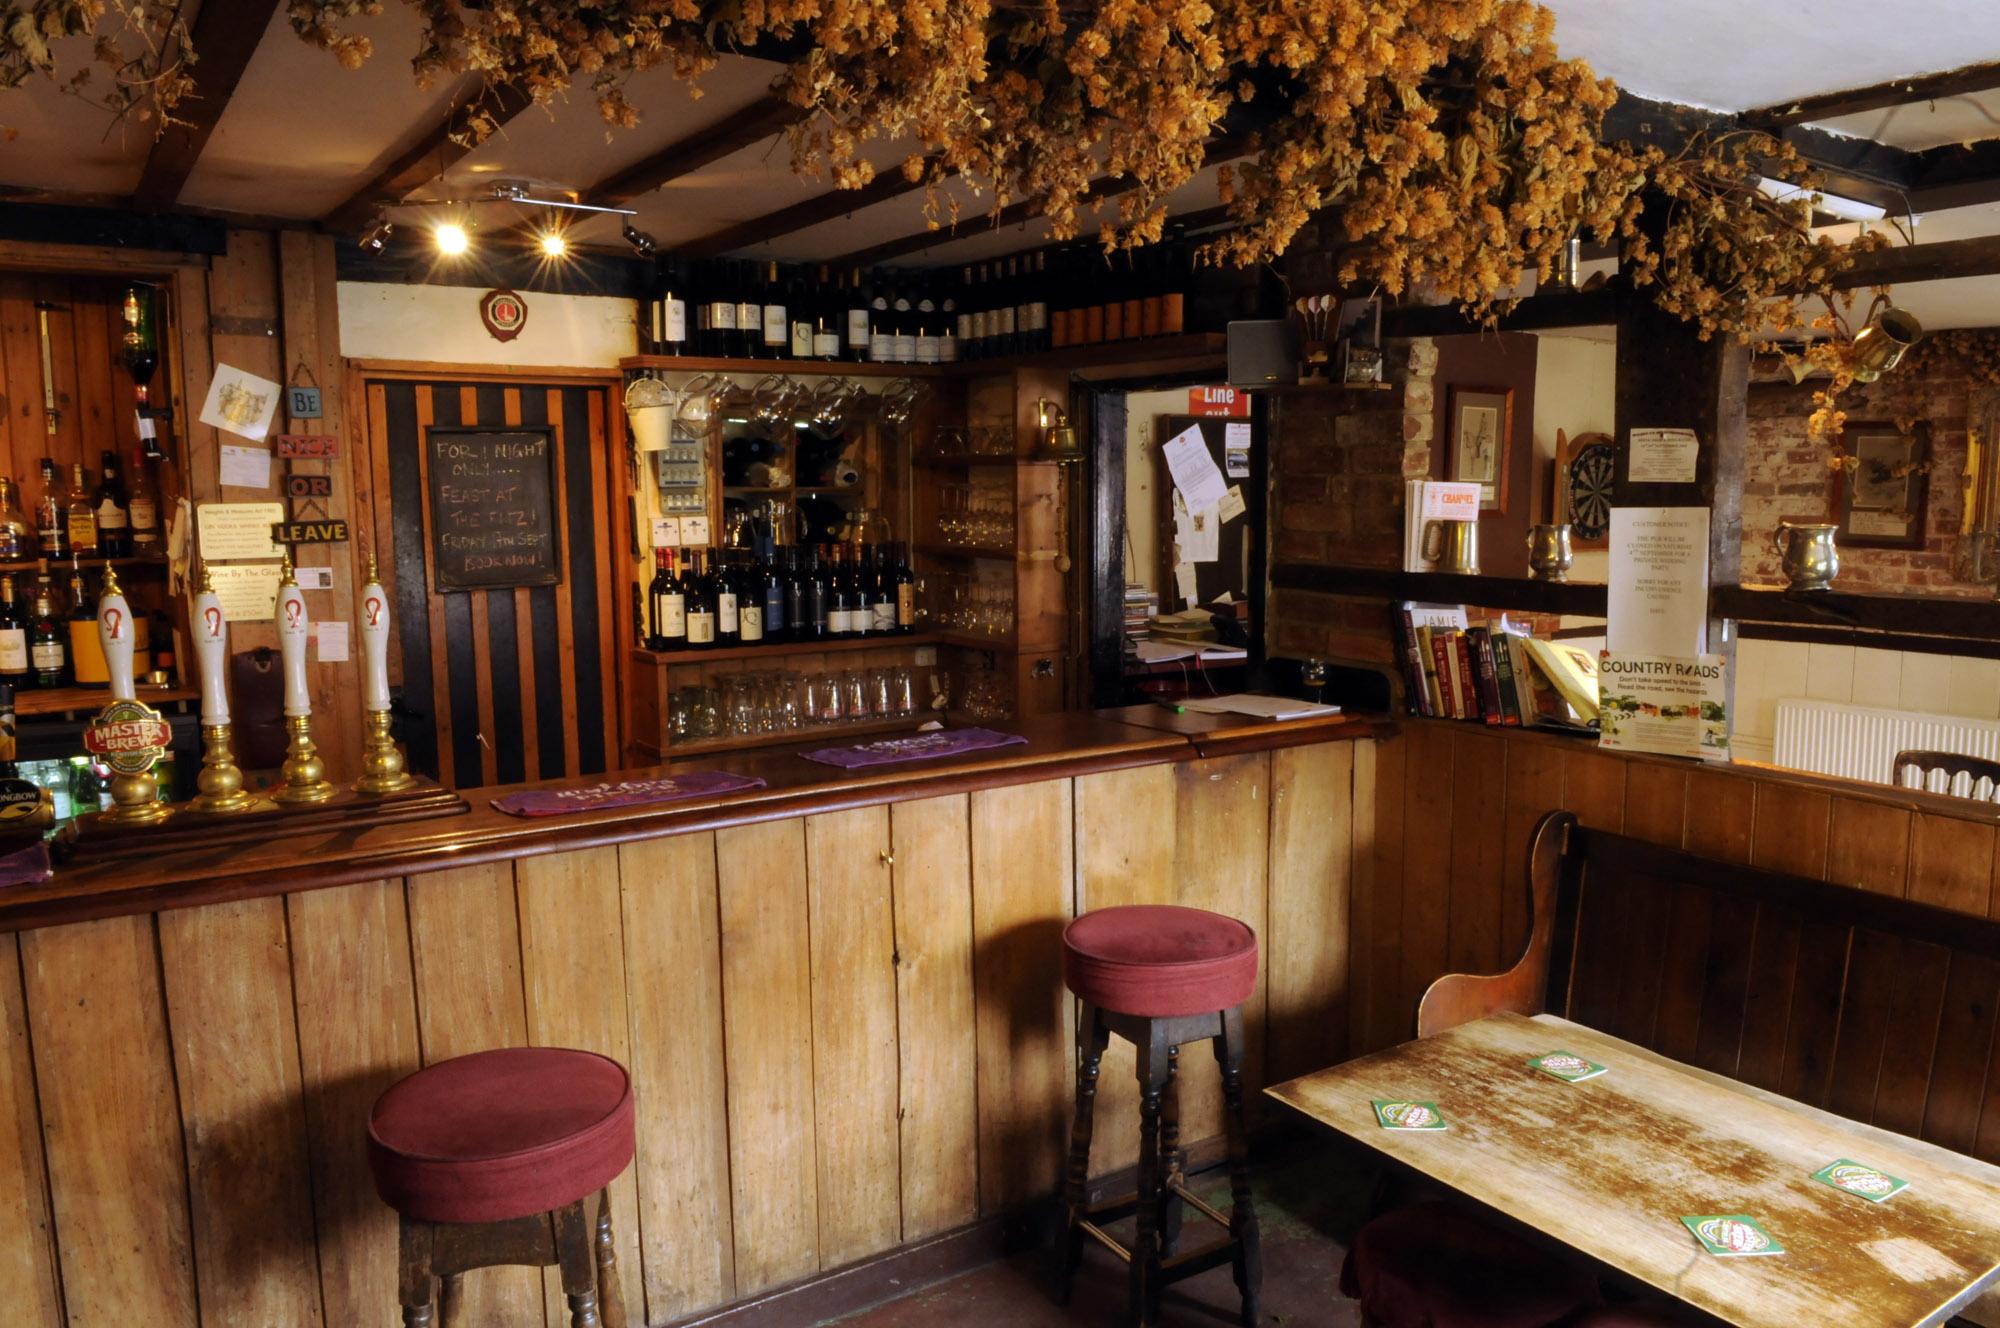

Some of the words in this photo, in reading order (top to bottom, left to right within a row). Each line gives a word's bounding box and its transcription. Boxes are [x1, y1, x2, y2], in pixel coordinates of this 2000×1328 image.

[293, 392, 319, 413] BE
[1204, 386, 1235, 404] Line
[281, 439, 333, 454] NICE
[437, 442, 479, 459] FOR
[495, 440, 546, 460] NIGHT
[290, 478, 330, 496] OR
[441, 485, 491, 504] FEAST
[495, 486, 519, 504] AT
[450, 510, 482, 529] THE
[278, 523, 346, 542] LEAVE
[442, 532, 487, 550] FRIDAY
[245, 568, 258, 577] The
[464, 555, 502, 572] BOOK
[1424, 615, 1458, 627] JAMIE
[1600, 660, 1673, 676] COUNTRY
[1675, 663, 1720, 679] RADS
[94, 719, 165, 743] MASTER
[106, 734, 152, 750] BREW
[0, 791, 37, 802] NGBOW
